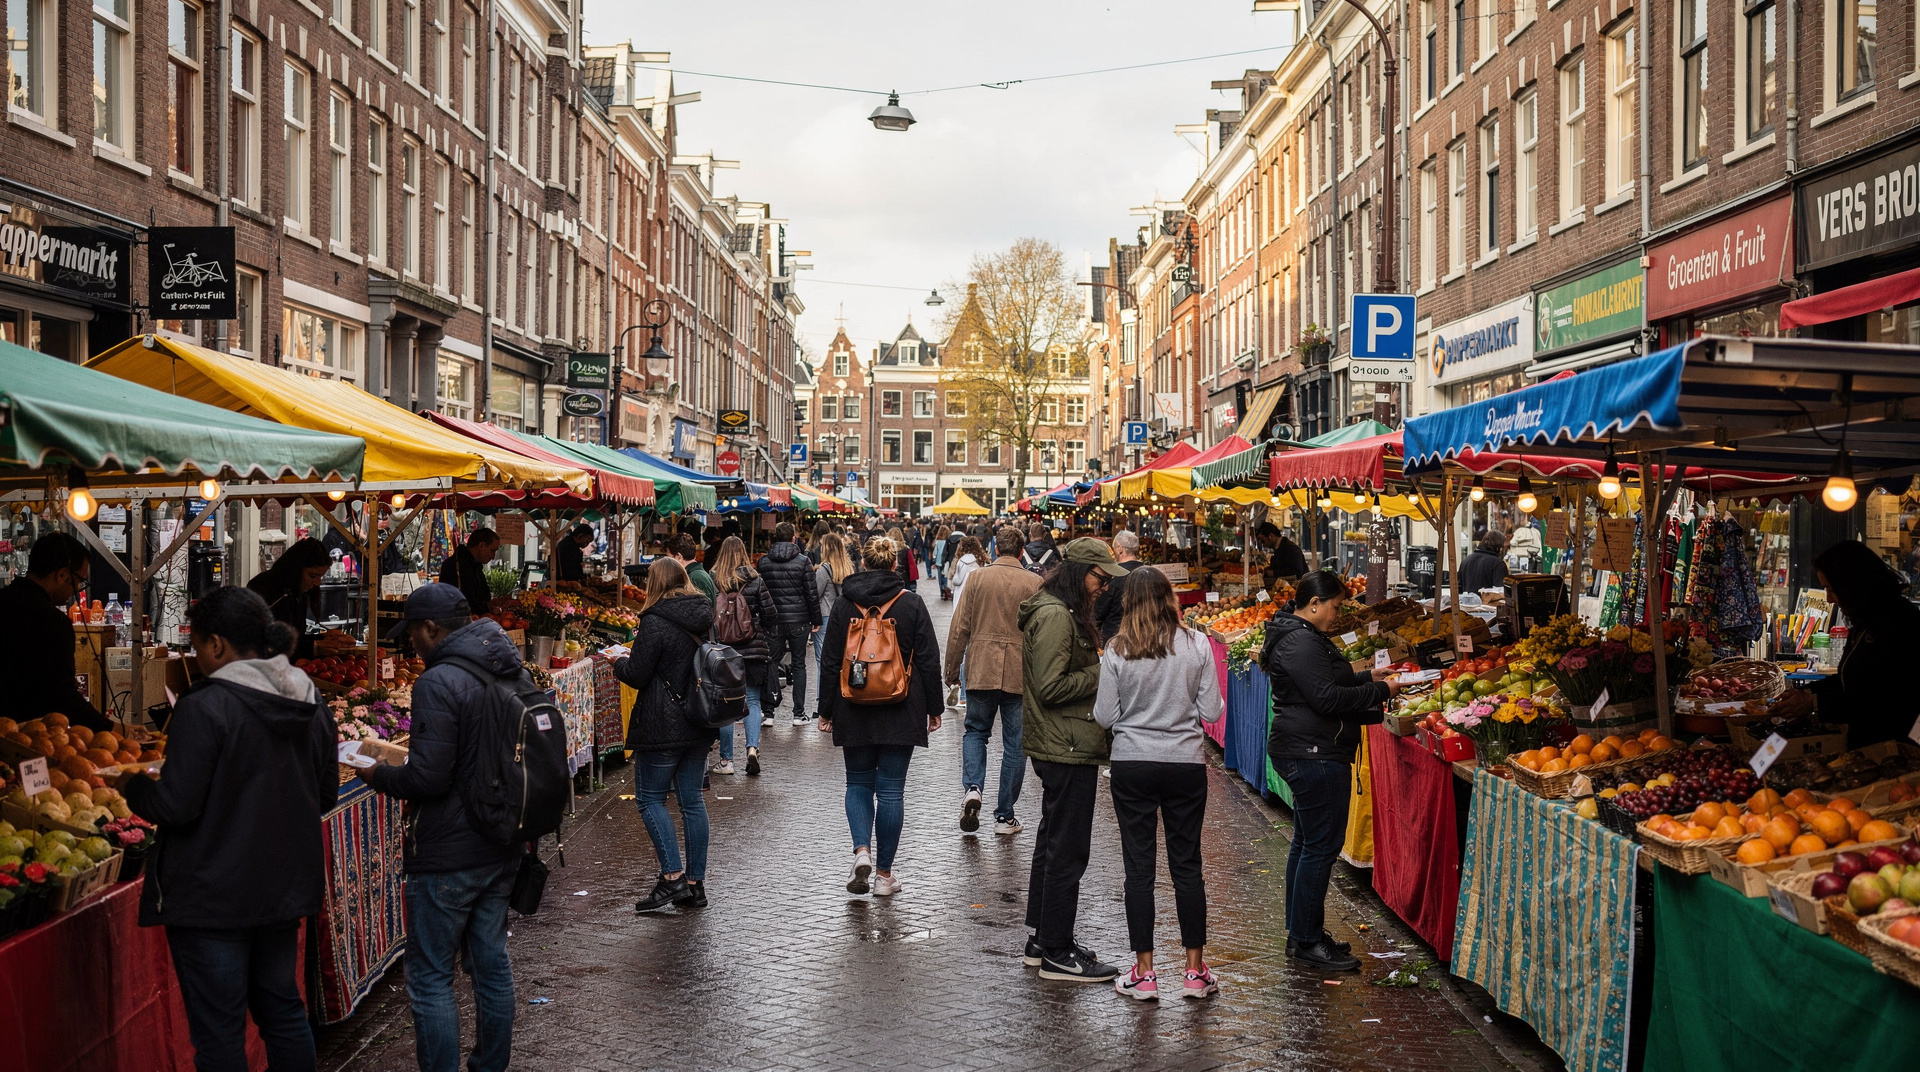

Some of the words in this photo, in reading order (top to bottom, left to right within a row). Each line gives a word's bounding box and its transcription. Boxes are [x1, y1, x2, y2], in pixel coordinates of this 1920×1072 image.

[1817, 181, 1867, 242] VERS
[1875, 162, 1920, 227] BRO
[0, 223, 118, 281] appermarkt
[1667, 248, 1719, 290] Groenten
[1721, 233, 1731, 273] &
[1735, 224, 1766, 271] Fruit
[1366, 304, 1403, 353] P
[1132, 425, 1143, 441] P
